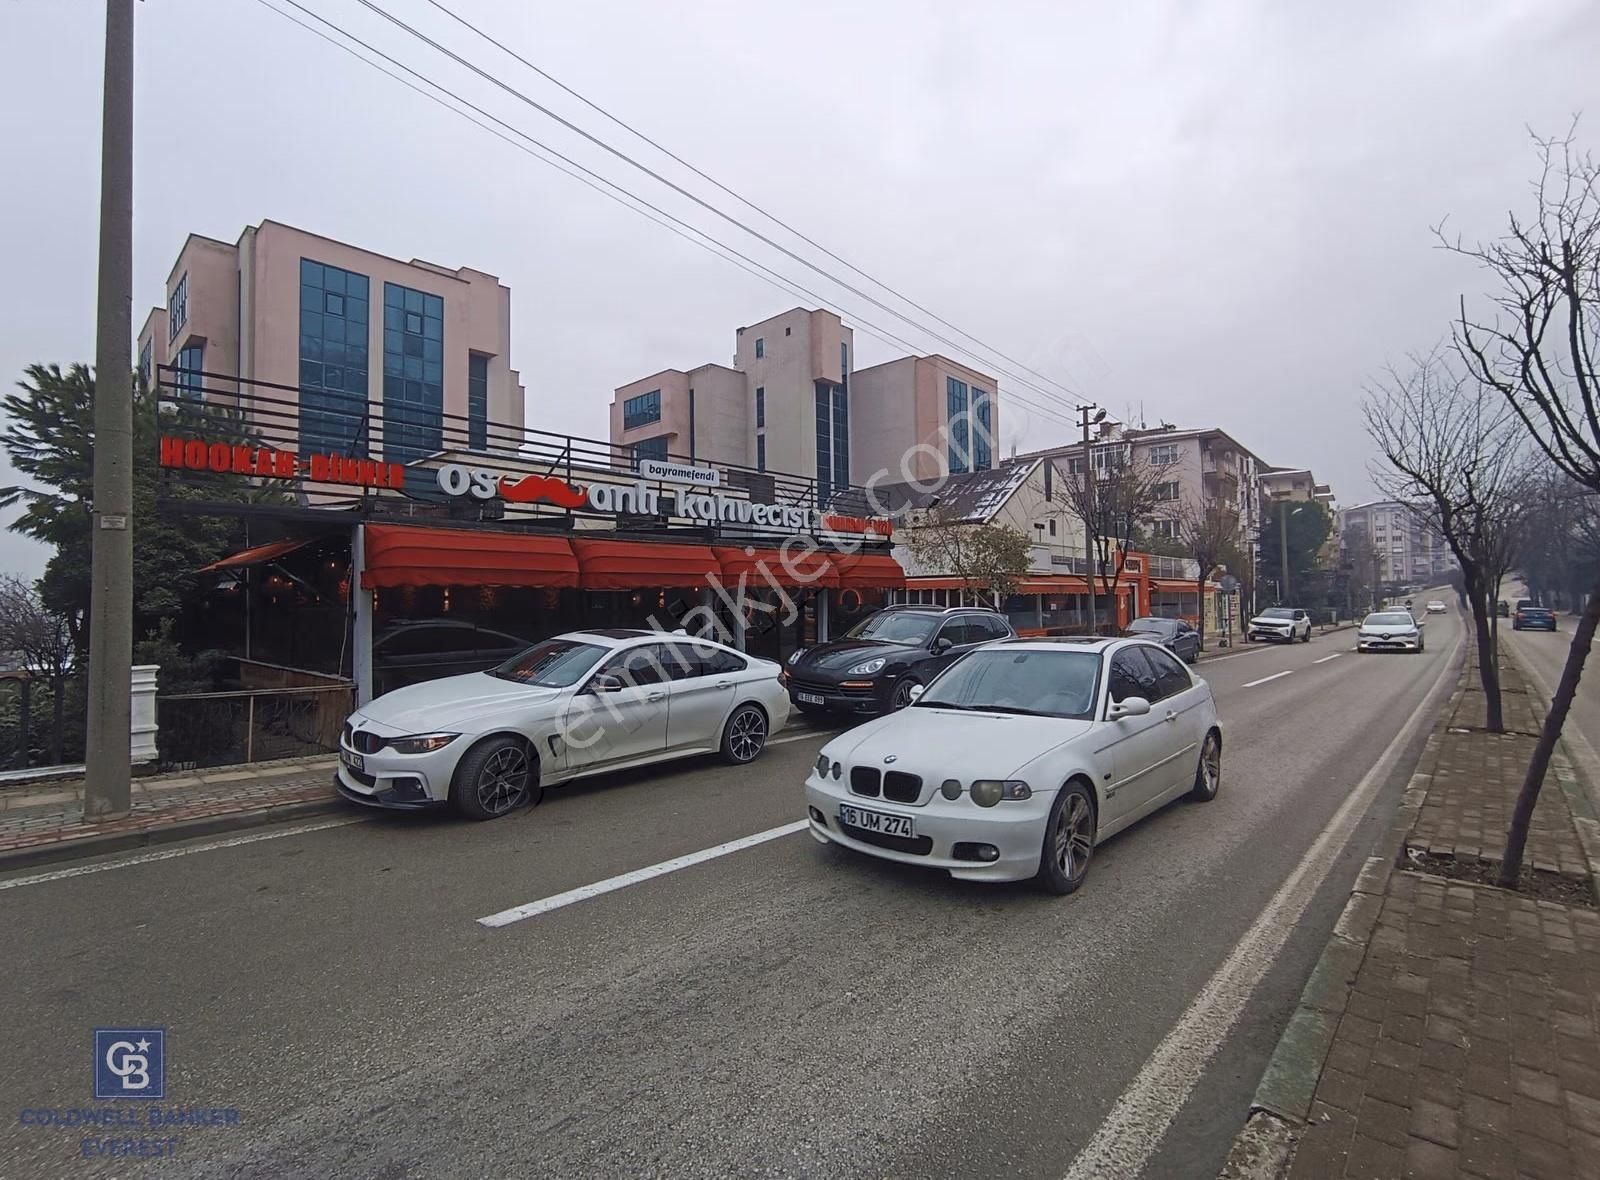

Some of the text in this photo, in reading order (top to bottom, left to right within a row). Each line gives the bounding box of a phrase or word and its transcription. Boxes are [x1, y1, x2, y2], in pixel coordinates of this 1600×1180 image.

[649, 464, 715, 481] bayramefendi
[675, 487, 812, 528] kahvecisi
[846, 808, 910, 836] 16 UM 274
